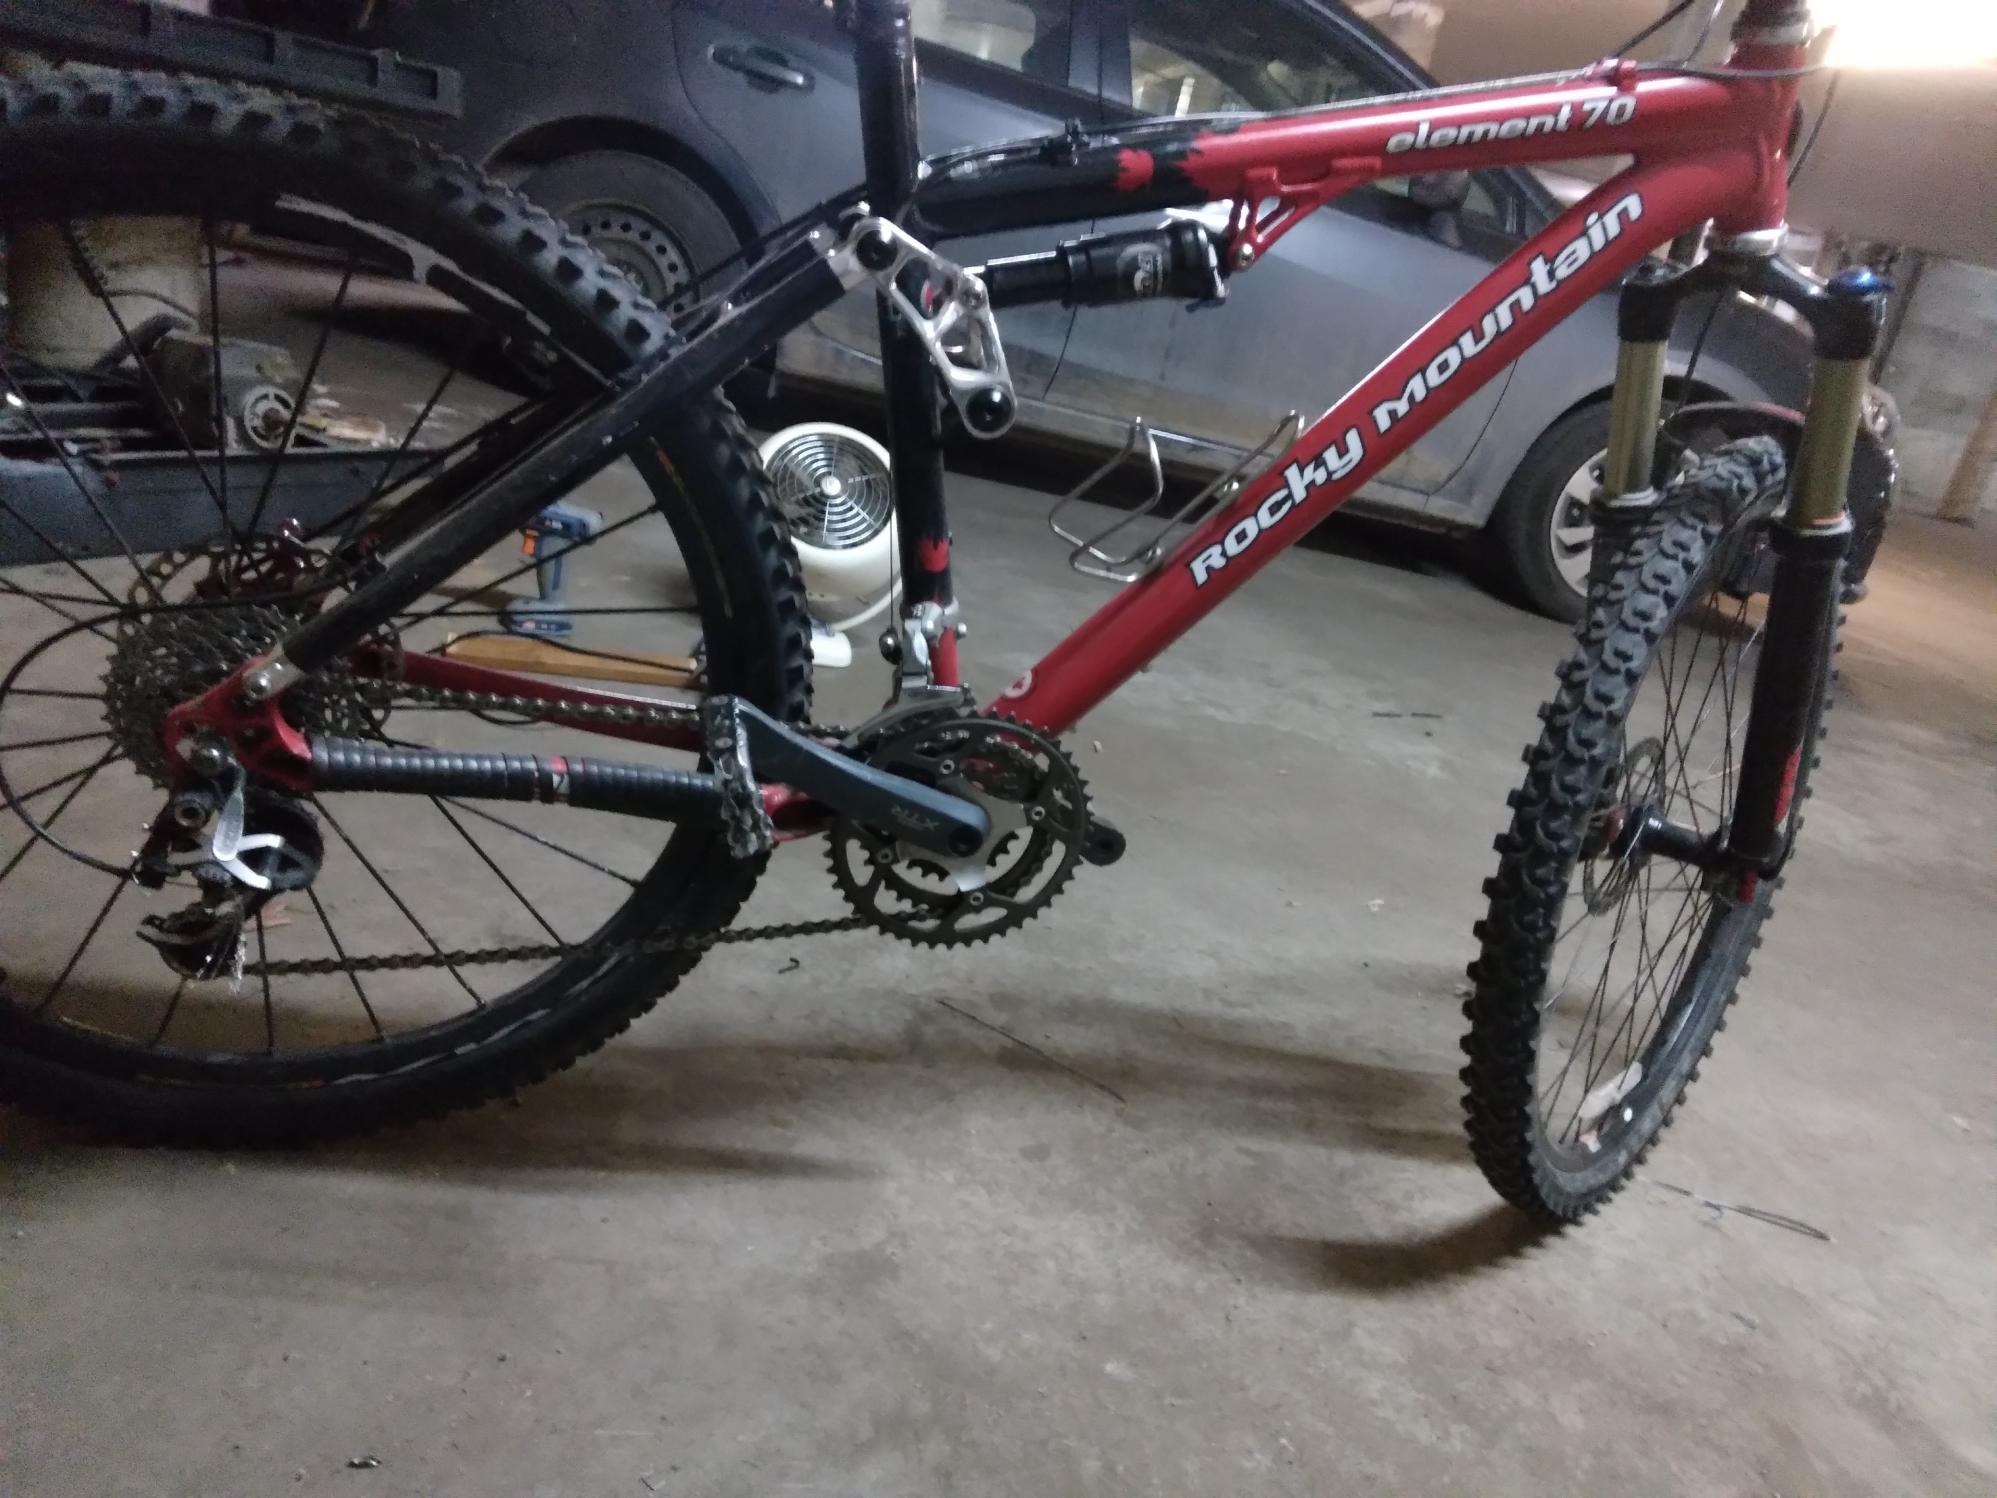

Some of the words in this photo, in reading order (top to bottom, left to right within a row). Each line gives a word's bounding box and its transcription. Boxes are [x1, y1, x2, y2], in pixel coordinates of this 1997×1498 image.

[1386, 102, 1572, 153] element
[1582, 97, 1636, 130] 70
[1190, 429, 1364, 586] Rocky
[1373, 192, 1643, 435] Mountain
